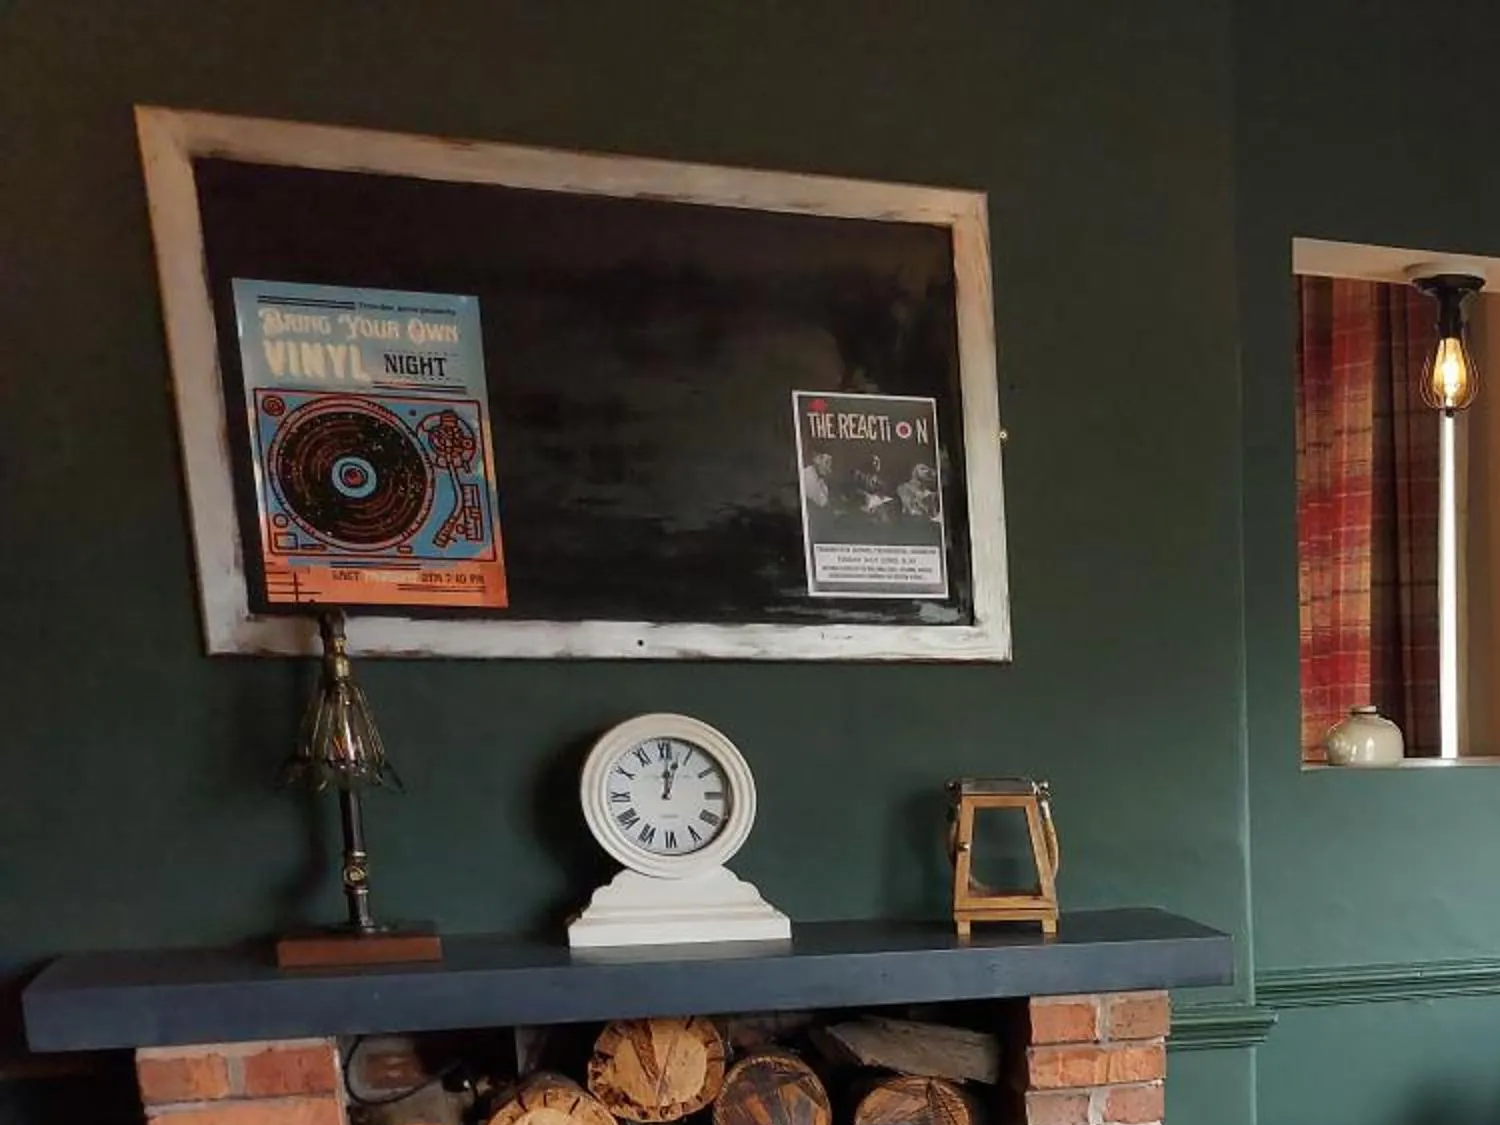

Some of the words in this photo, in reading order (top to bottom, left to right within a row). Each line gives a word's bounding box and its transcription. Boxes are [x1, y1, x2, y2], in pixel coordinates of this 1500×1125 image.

[263, 339, 371, 383] VINYL
[384, 353, 447, 377] NIGHT
[807, 412, 836, 439] THE
